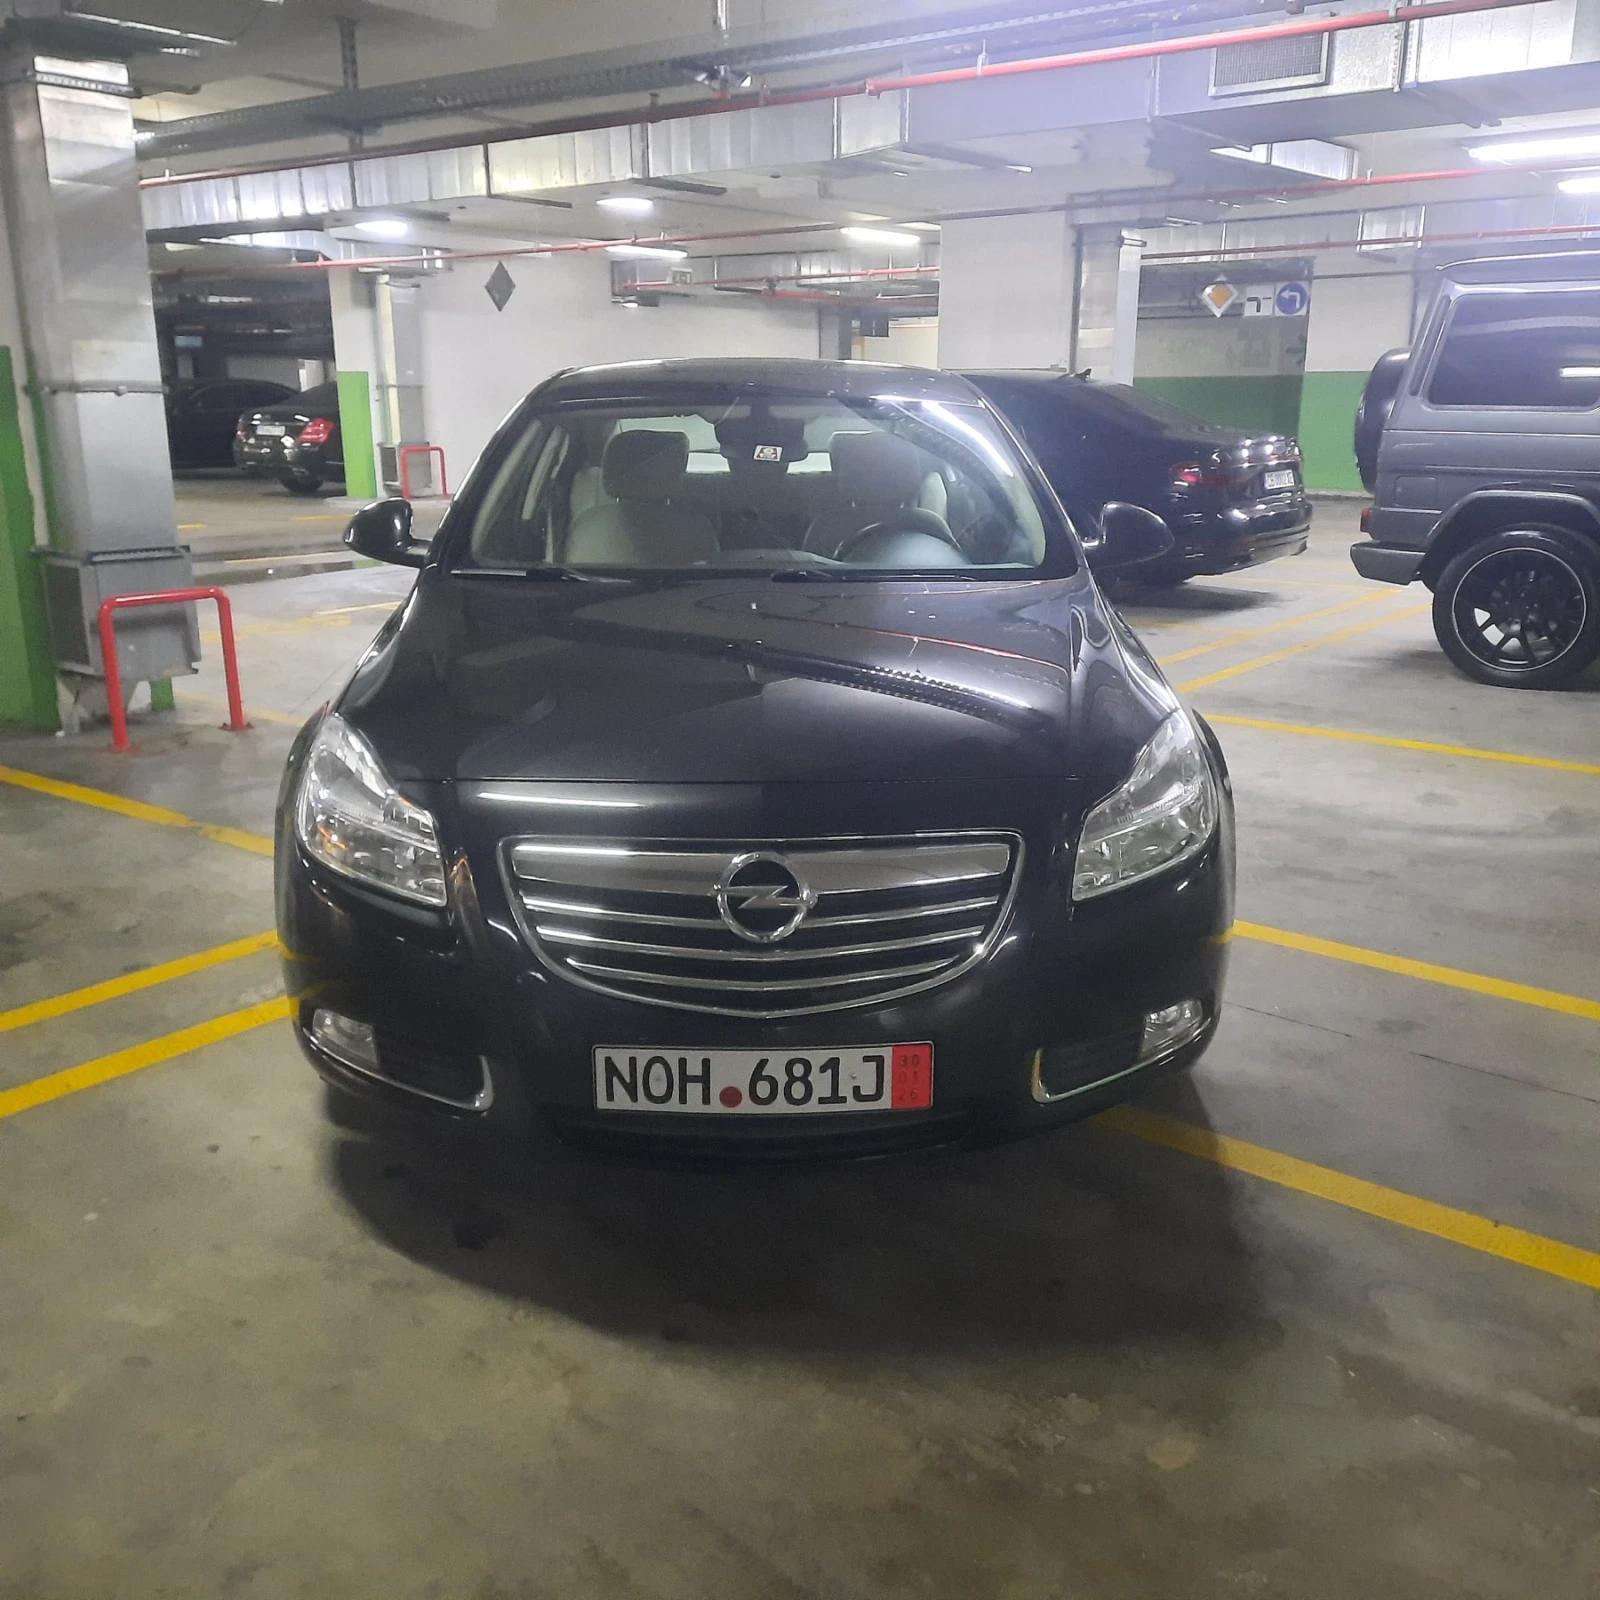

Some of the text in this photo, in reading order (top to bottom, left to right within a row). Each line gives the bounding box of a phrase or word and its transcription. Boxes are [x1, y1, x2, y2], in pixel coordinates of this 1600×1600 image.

[900, 1054, 920, 1067] 30
[604, 1055, 885, 1106] NOH 681J
